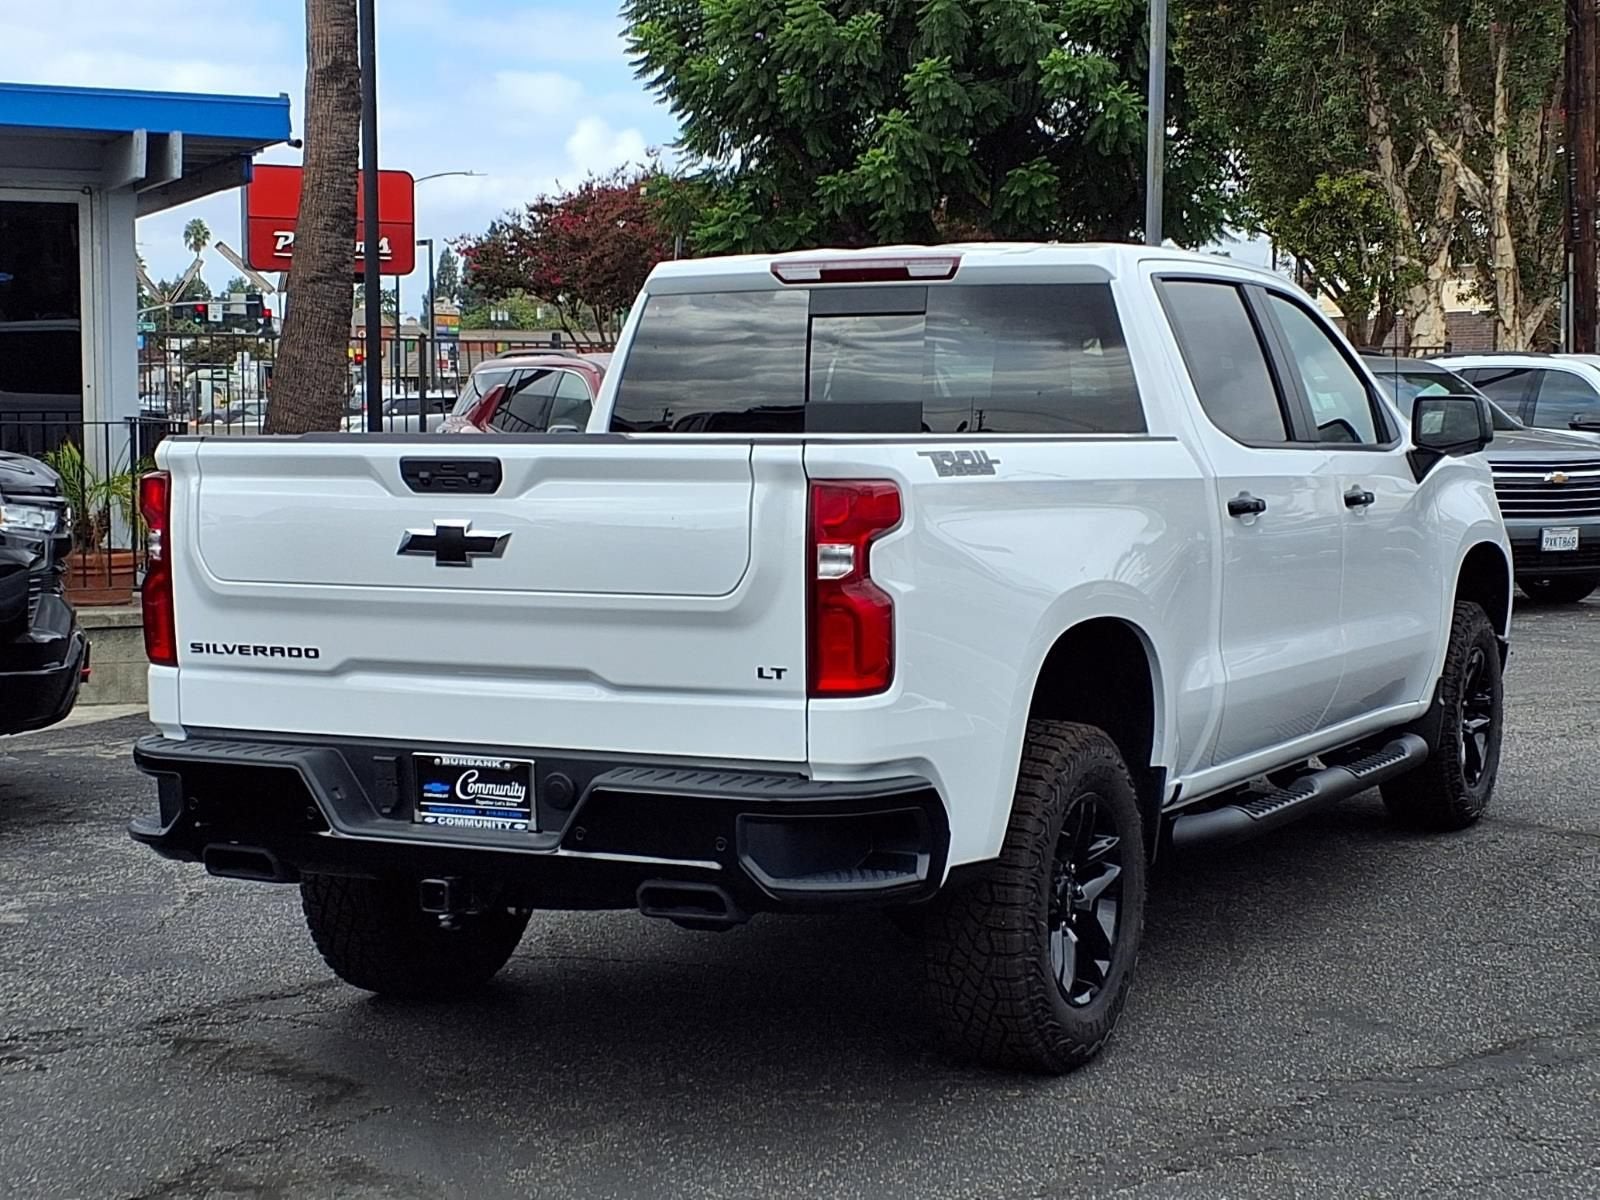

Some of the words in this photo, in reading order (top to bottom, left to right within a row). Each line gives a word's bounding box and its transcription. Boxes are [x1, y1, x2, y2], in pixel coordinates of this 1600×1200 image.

[190, 642, 320, 659] SILVERADO
[757, 667, 788, 680] LT
[441, 757, 501, 768] BURBANK
[455, 769, 526, 803] Community
[438, 817, 511, 829] COMMUNITY
